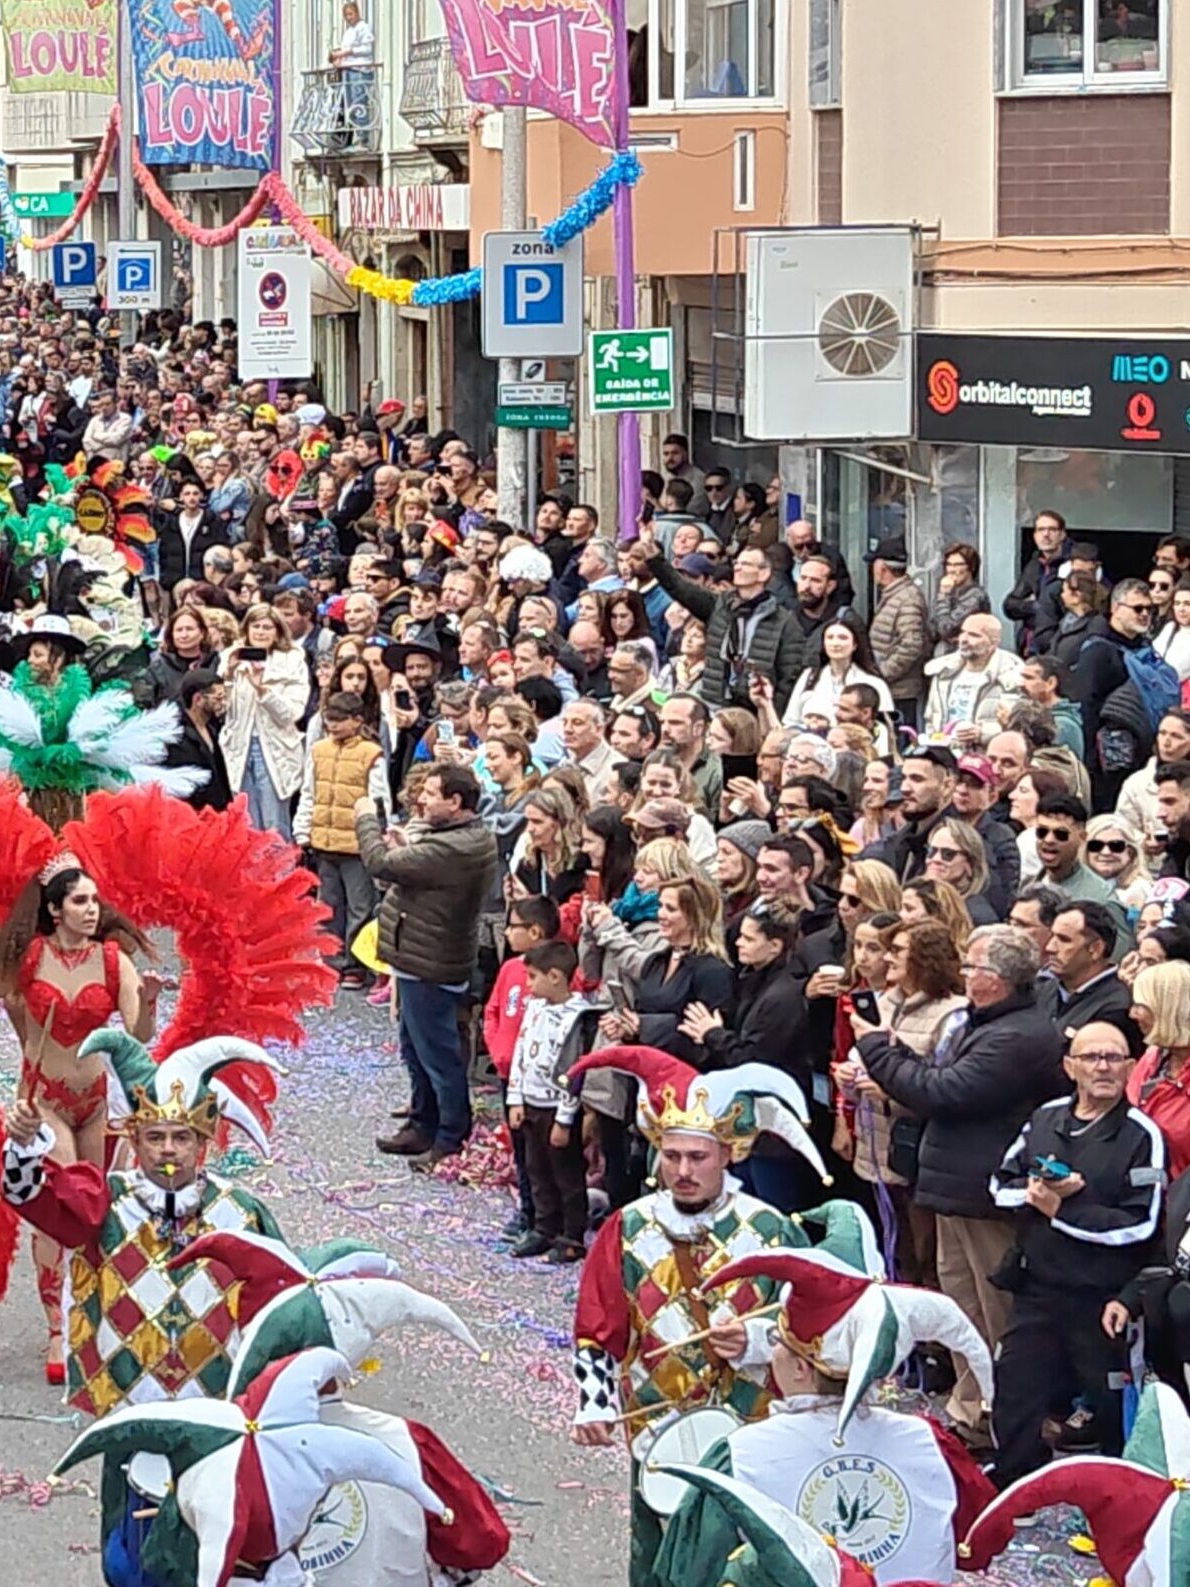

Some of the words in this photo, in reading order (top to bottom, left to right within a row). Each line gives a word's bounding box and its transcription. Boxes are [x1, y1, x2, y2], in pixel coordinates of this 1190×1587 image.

[9, 24, 110, 78] LOULÉ
[142, 78, 271, 154] LOULÉ
[30, 197, 49, 212] CA
[349, 186, 385, 228] BAZAR
[388, 186, 402, 228] DA
[407, 185, 444, 228] CHINA
[511, 243, 554, 255] zona
[62, 247, 87, 283] P
[516, 269, 551, 319] P
[605, 378, 641, 389] SAÍDA
[643, 377, 659, 388] DE
[1113, 355, 1169, 383] MEO
[595, 390, 670, 403] EMERGÊNCIA
[959, 382, 1092, 407] orbitalconnect
